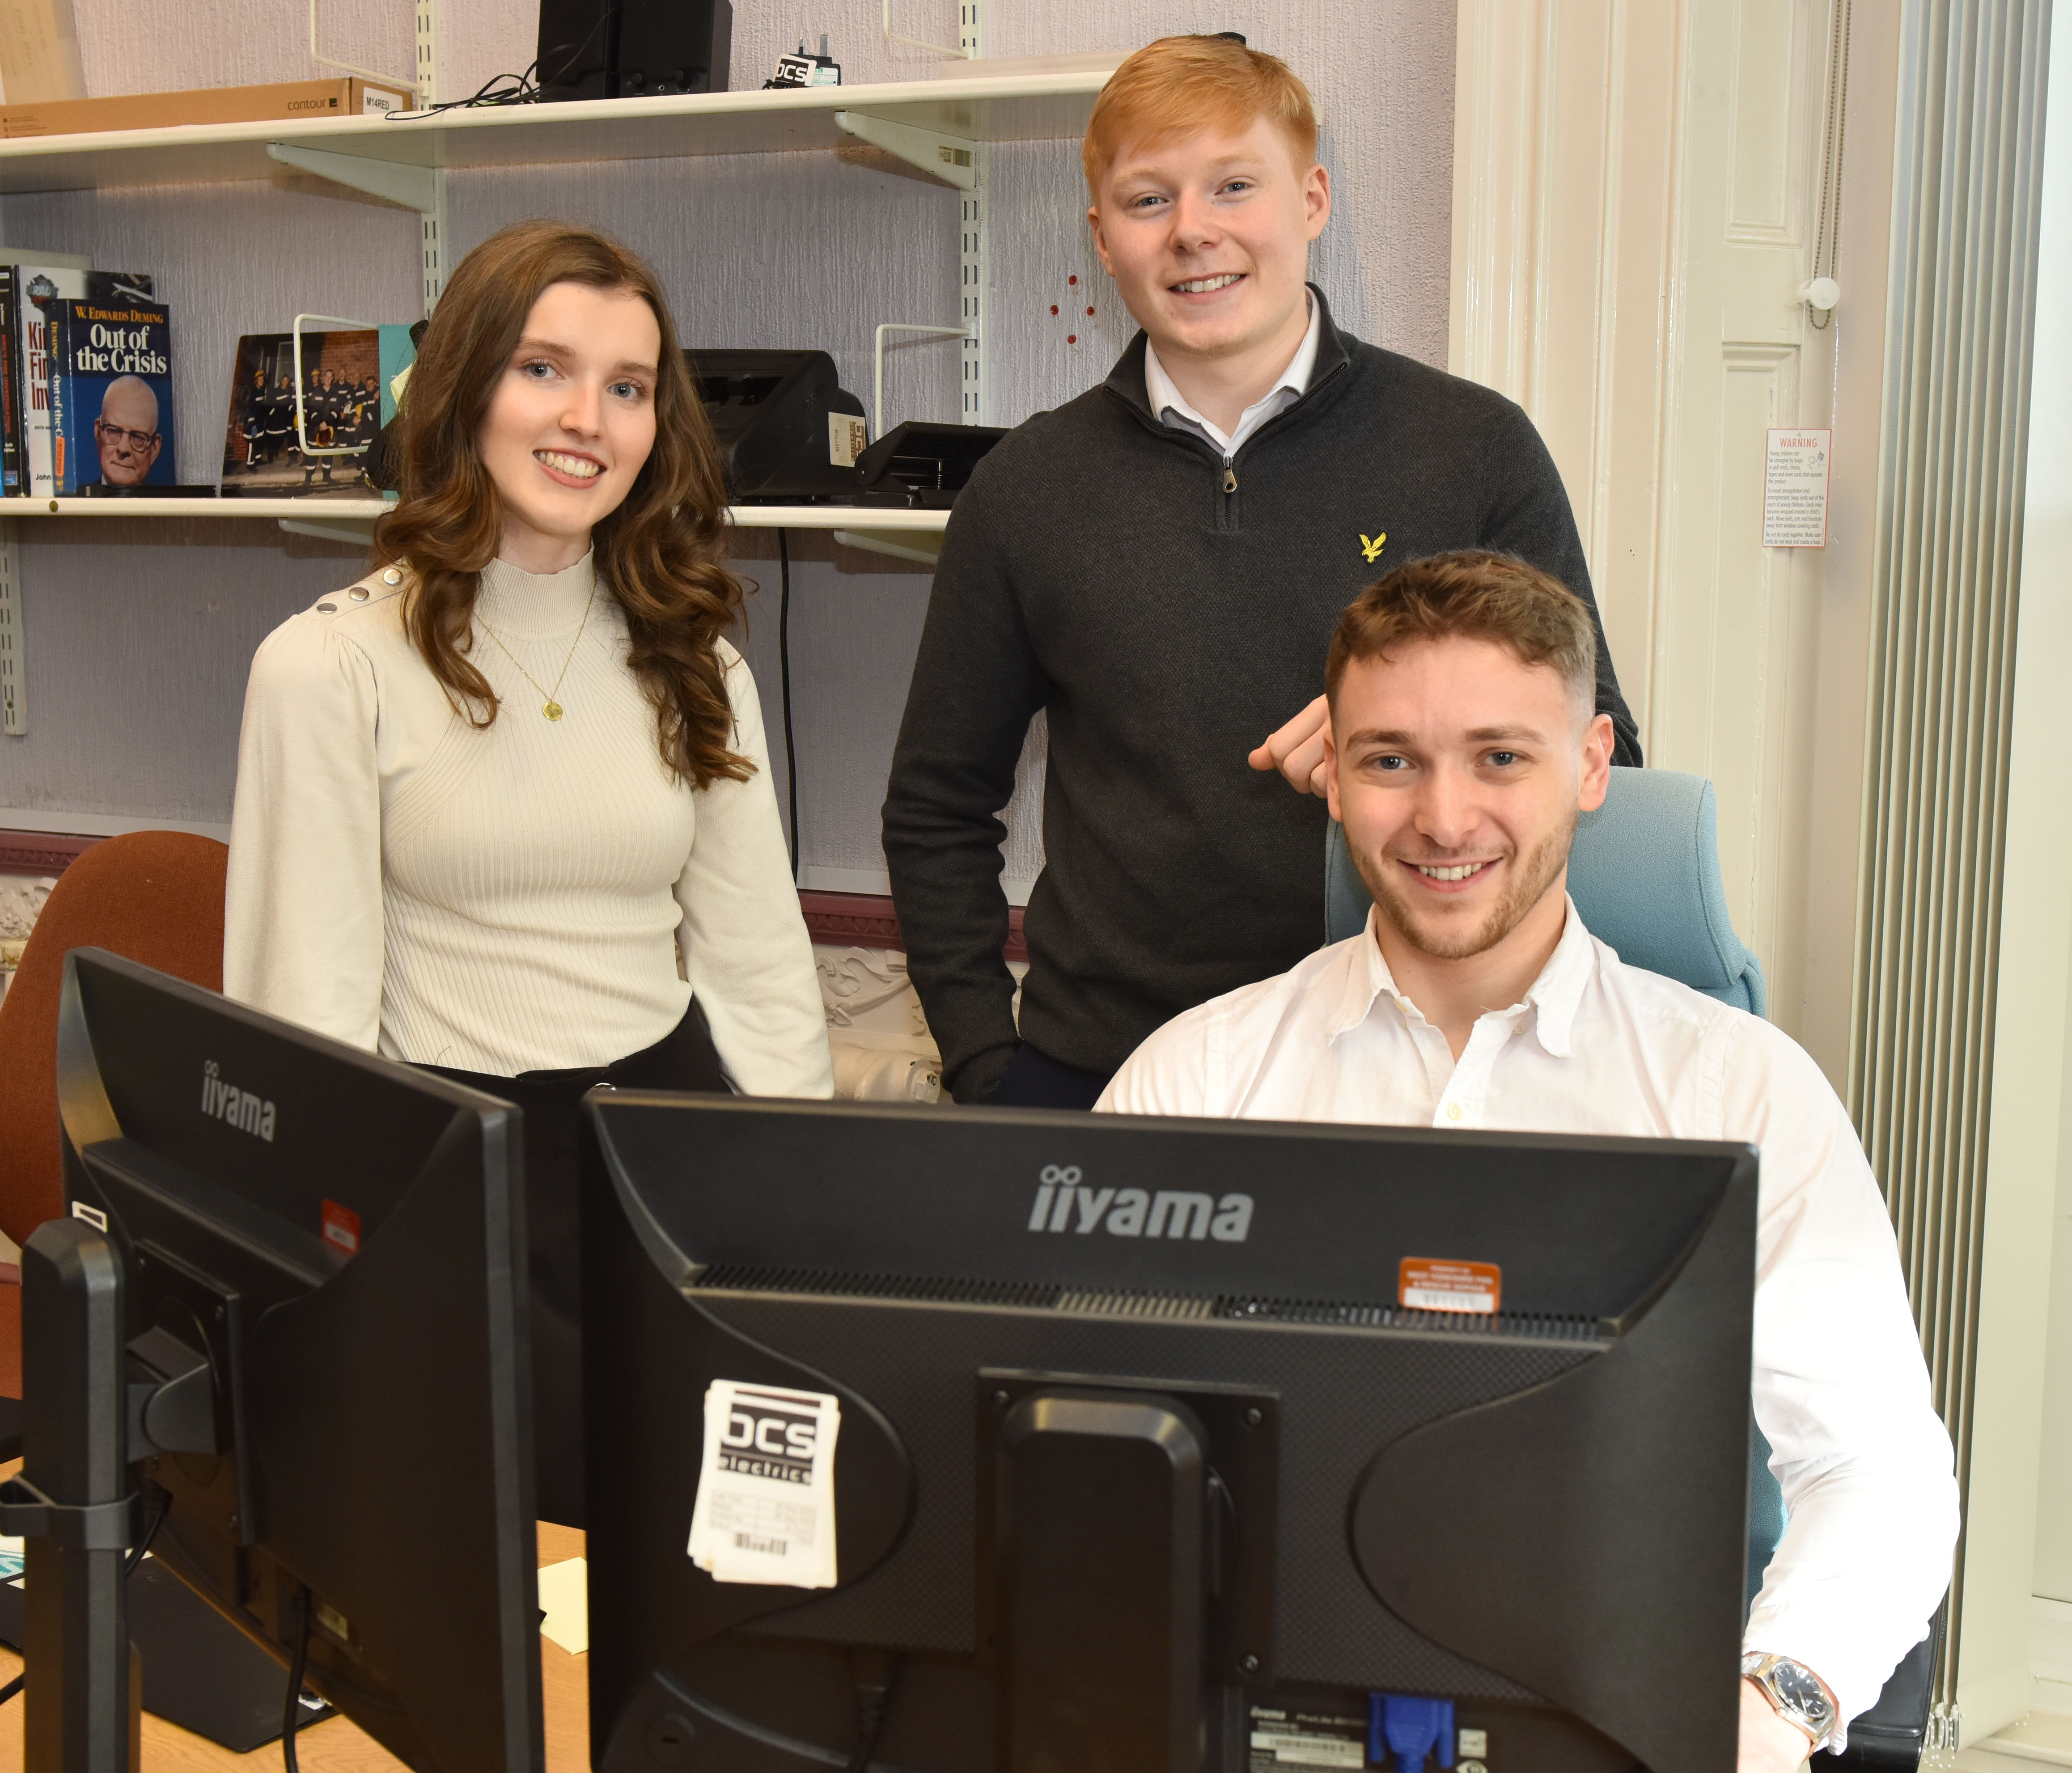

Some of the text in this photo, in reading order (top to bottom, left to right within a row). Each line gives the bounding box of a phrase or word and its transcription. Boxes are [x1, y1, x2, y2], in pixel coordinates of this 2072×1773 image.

[288, 99, 326, 110] contour
[366, 96, 390, 110] M14RED
[75, 305, 86, 319] W.
[90, 323, 150, 350] Out of
[76, 346, 167, 374] the Crisis
[3, 377, 12, 433] INVESTIGATION
[1780, 438, 1818, 448] WARNING
[201, 1059, 276, 1143] iiyama
[1028, 1164, 1254, 1243] iiyama
